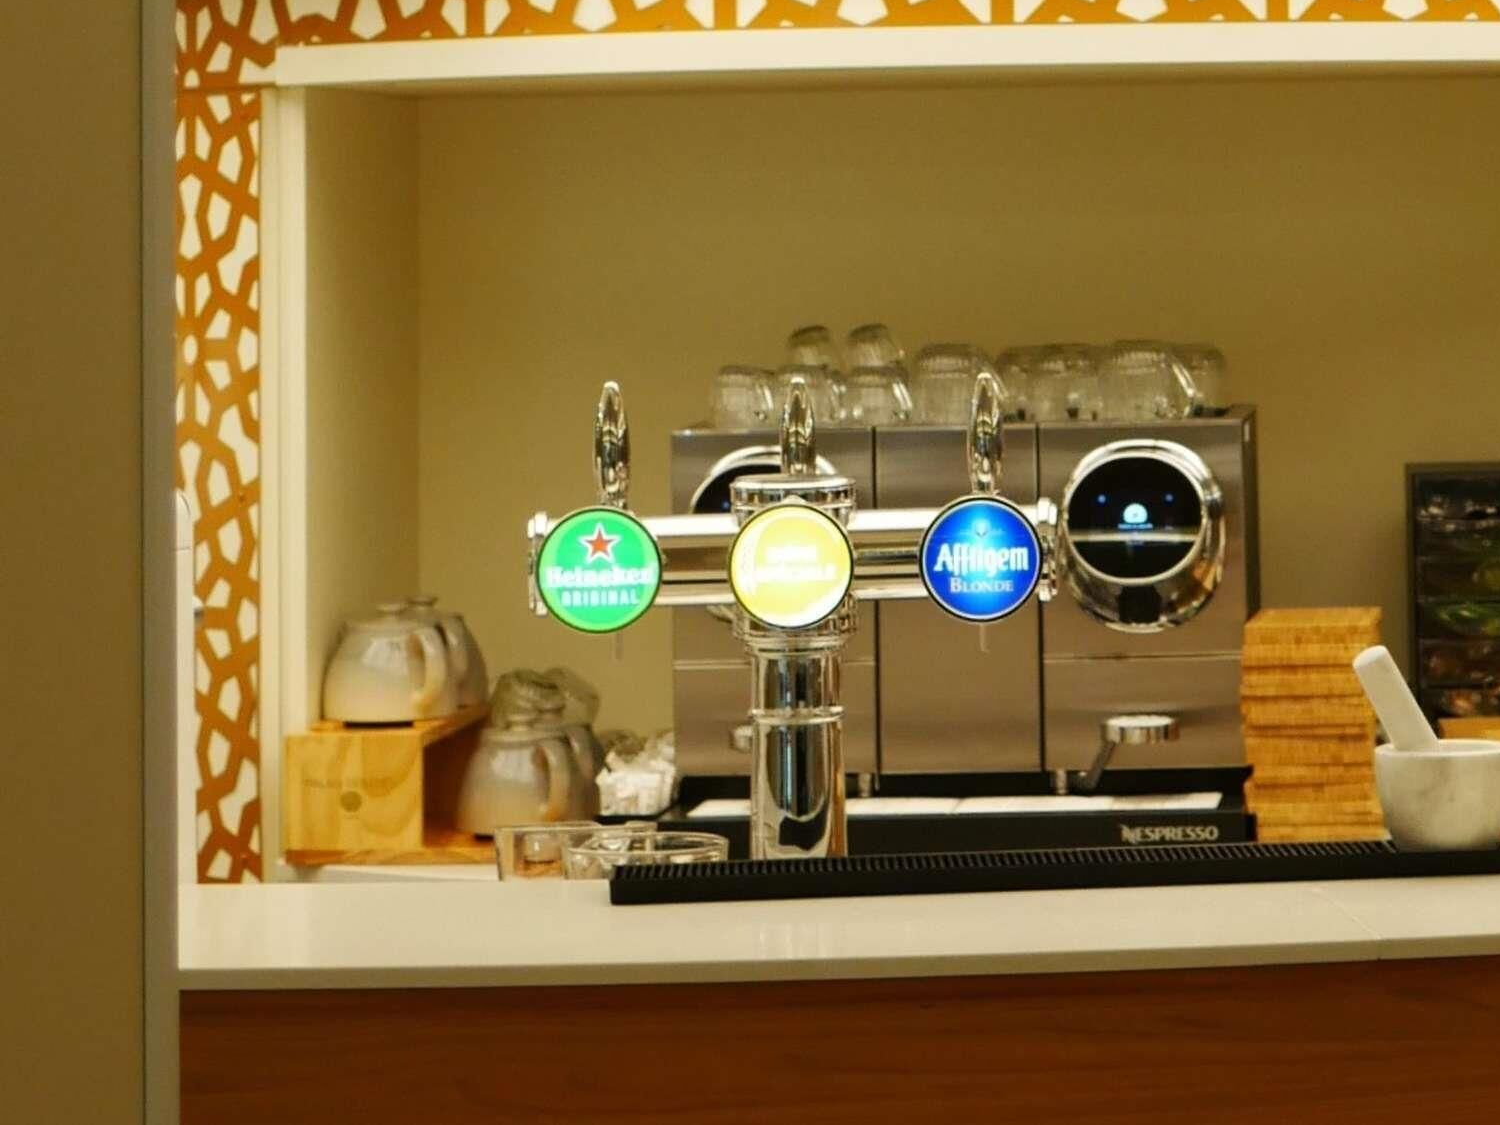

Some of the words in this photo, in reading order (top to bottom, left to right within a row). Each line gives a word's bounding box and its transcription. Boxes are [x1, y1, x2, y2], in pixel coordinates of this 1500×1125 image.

[933, 542, 1028, 577] Affligem
[949, 577, 1014, 592] BLONDE
[561, 589, 640, 606] ORIGINAL
[1121, 825, 1219, 843] NESPRESSO
